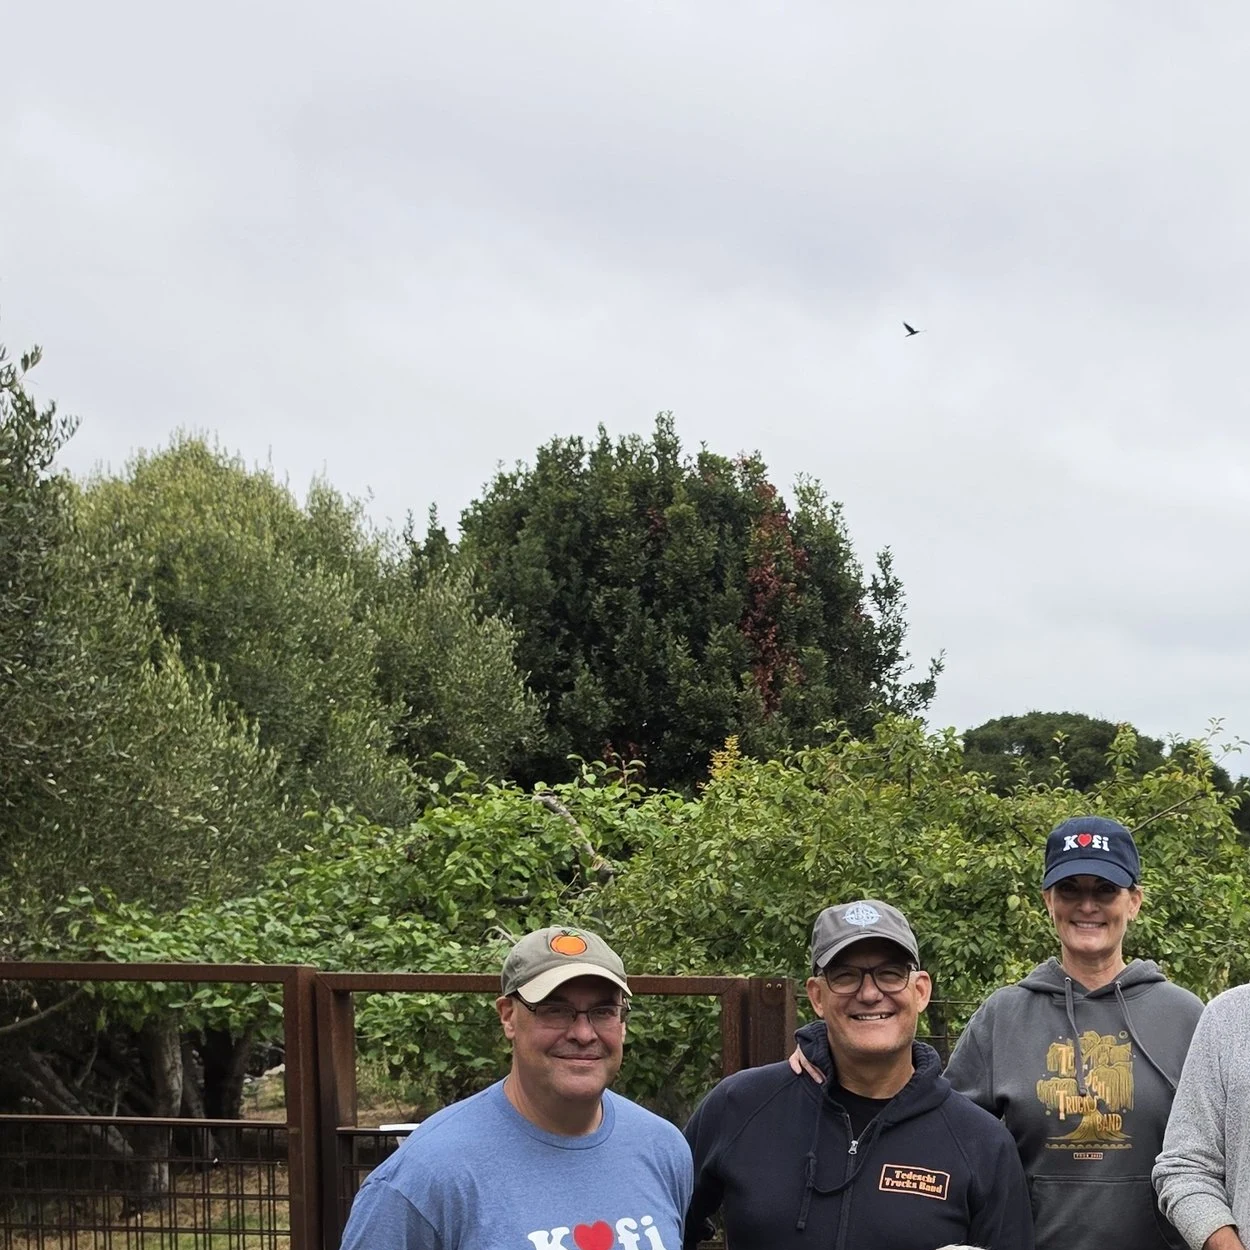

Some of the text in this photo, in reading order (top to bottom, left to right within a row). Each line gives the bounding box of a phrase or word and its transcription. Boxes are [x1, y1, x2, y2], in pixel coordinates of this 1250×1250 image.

[1096, 1113, 1123, 1132] BAND
[895, 1169, 937, 1184] Tedeschi
[884, 1177, 943, 1194] Trucks Band
